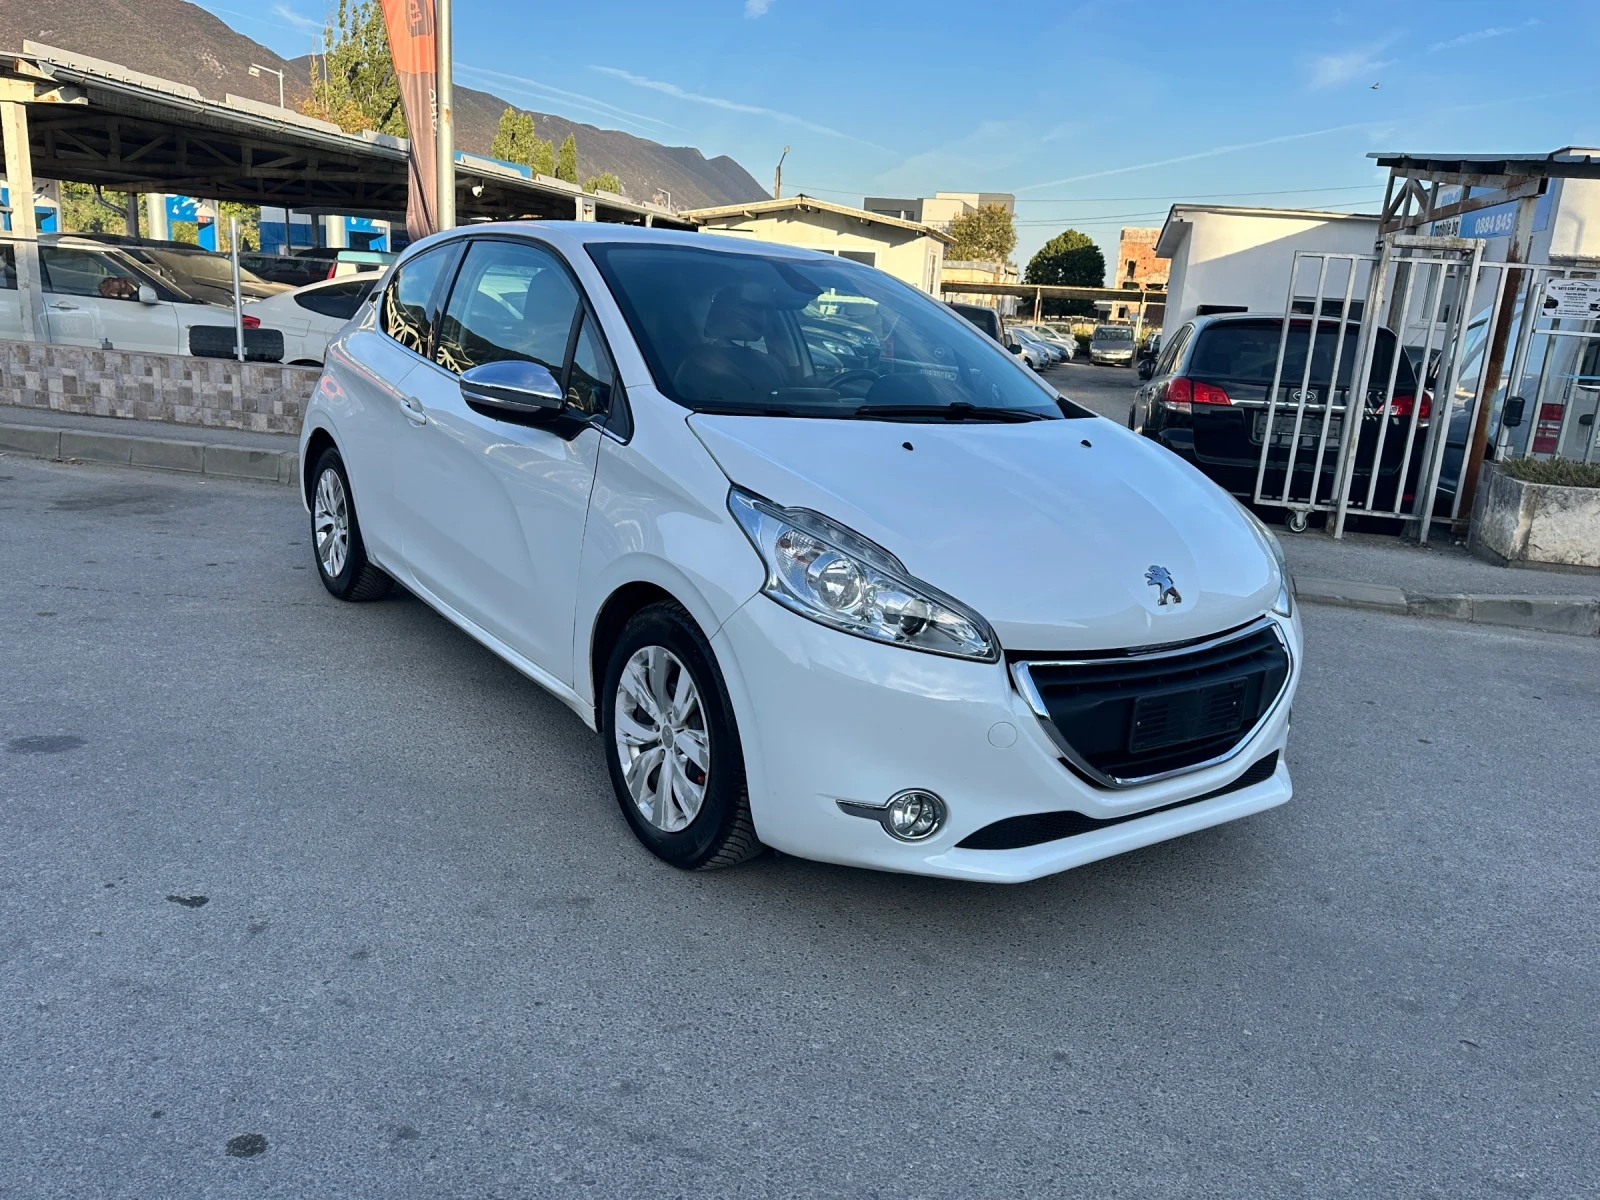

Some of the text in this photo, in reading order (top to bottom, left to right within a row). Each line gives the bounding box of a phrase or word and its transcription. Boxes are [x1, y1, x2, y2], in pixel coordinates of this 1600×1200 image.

[172, 205, 179, 214] 4
[351, 216, 357, 225] 6
[1475, 212, 1513, 235] 0884 845
[1434, 219, 1459, 237] mobile.bg
